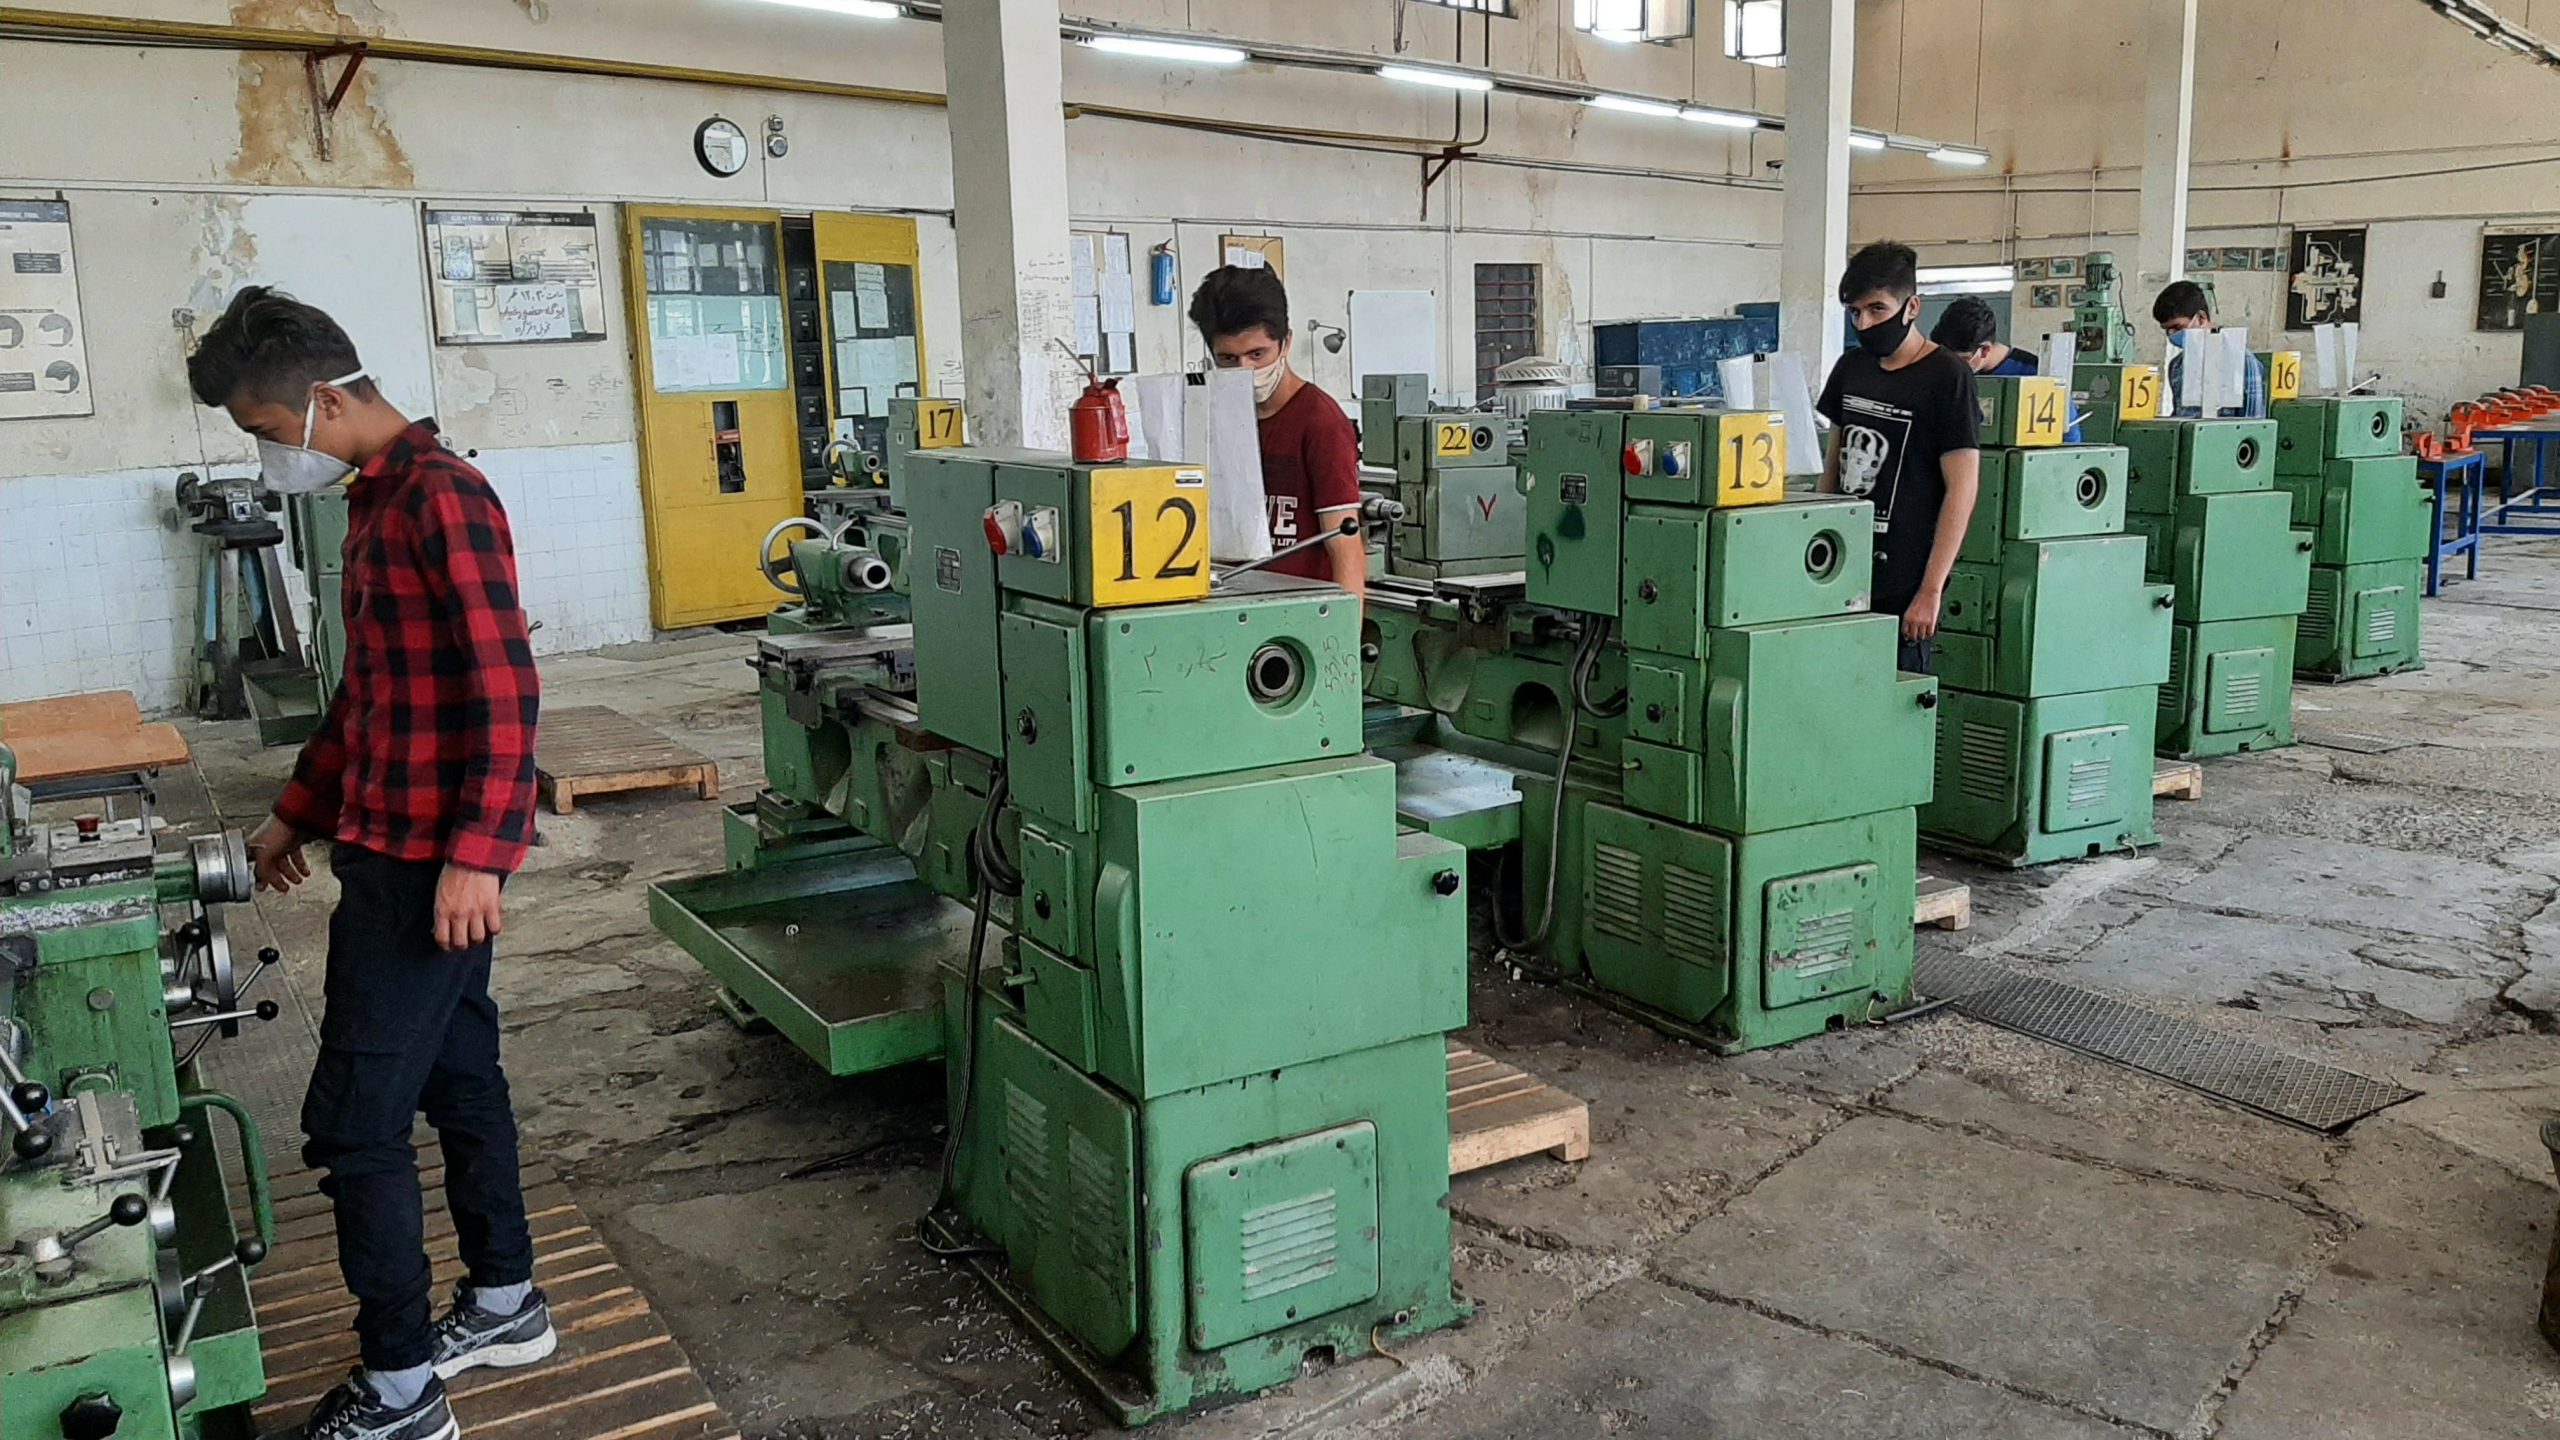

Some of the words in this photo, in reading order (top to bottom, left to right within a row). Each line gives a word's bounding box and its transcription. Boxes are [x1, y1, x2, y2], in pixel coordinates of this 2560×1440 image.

[2127, 376, 2152, 408] 15
[2275, 361, 2297, 390] 16
[928, 409, 954, 439] 17
[2025, 392, 2056, 434] 14
[1441, 425, 1467, 450] 22
[1728, 432, 1774, 489] 13
[1264, 495, 1298, 535] VE
[1111, 497, 1201, 582] 12
